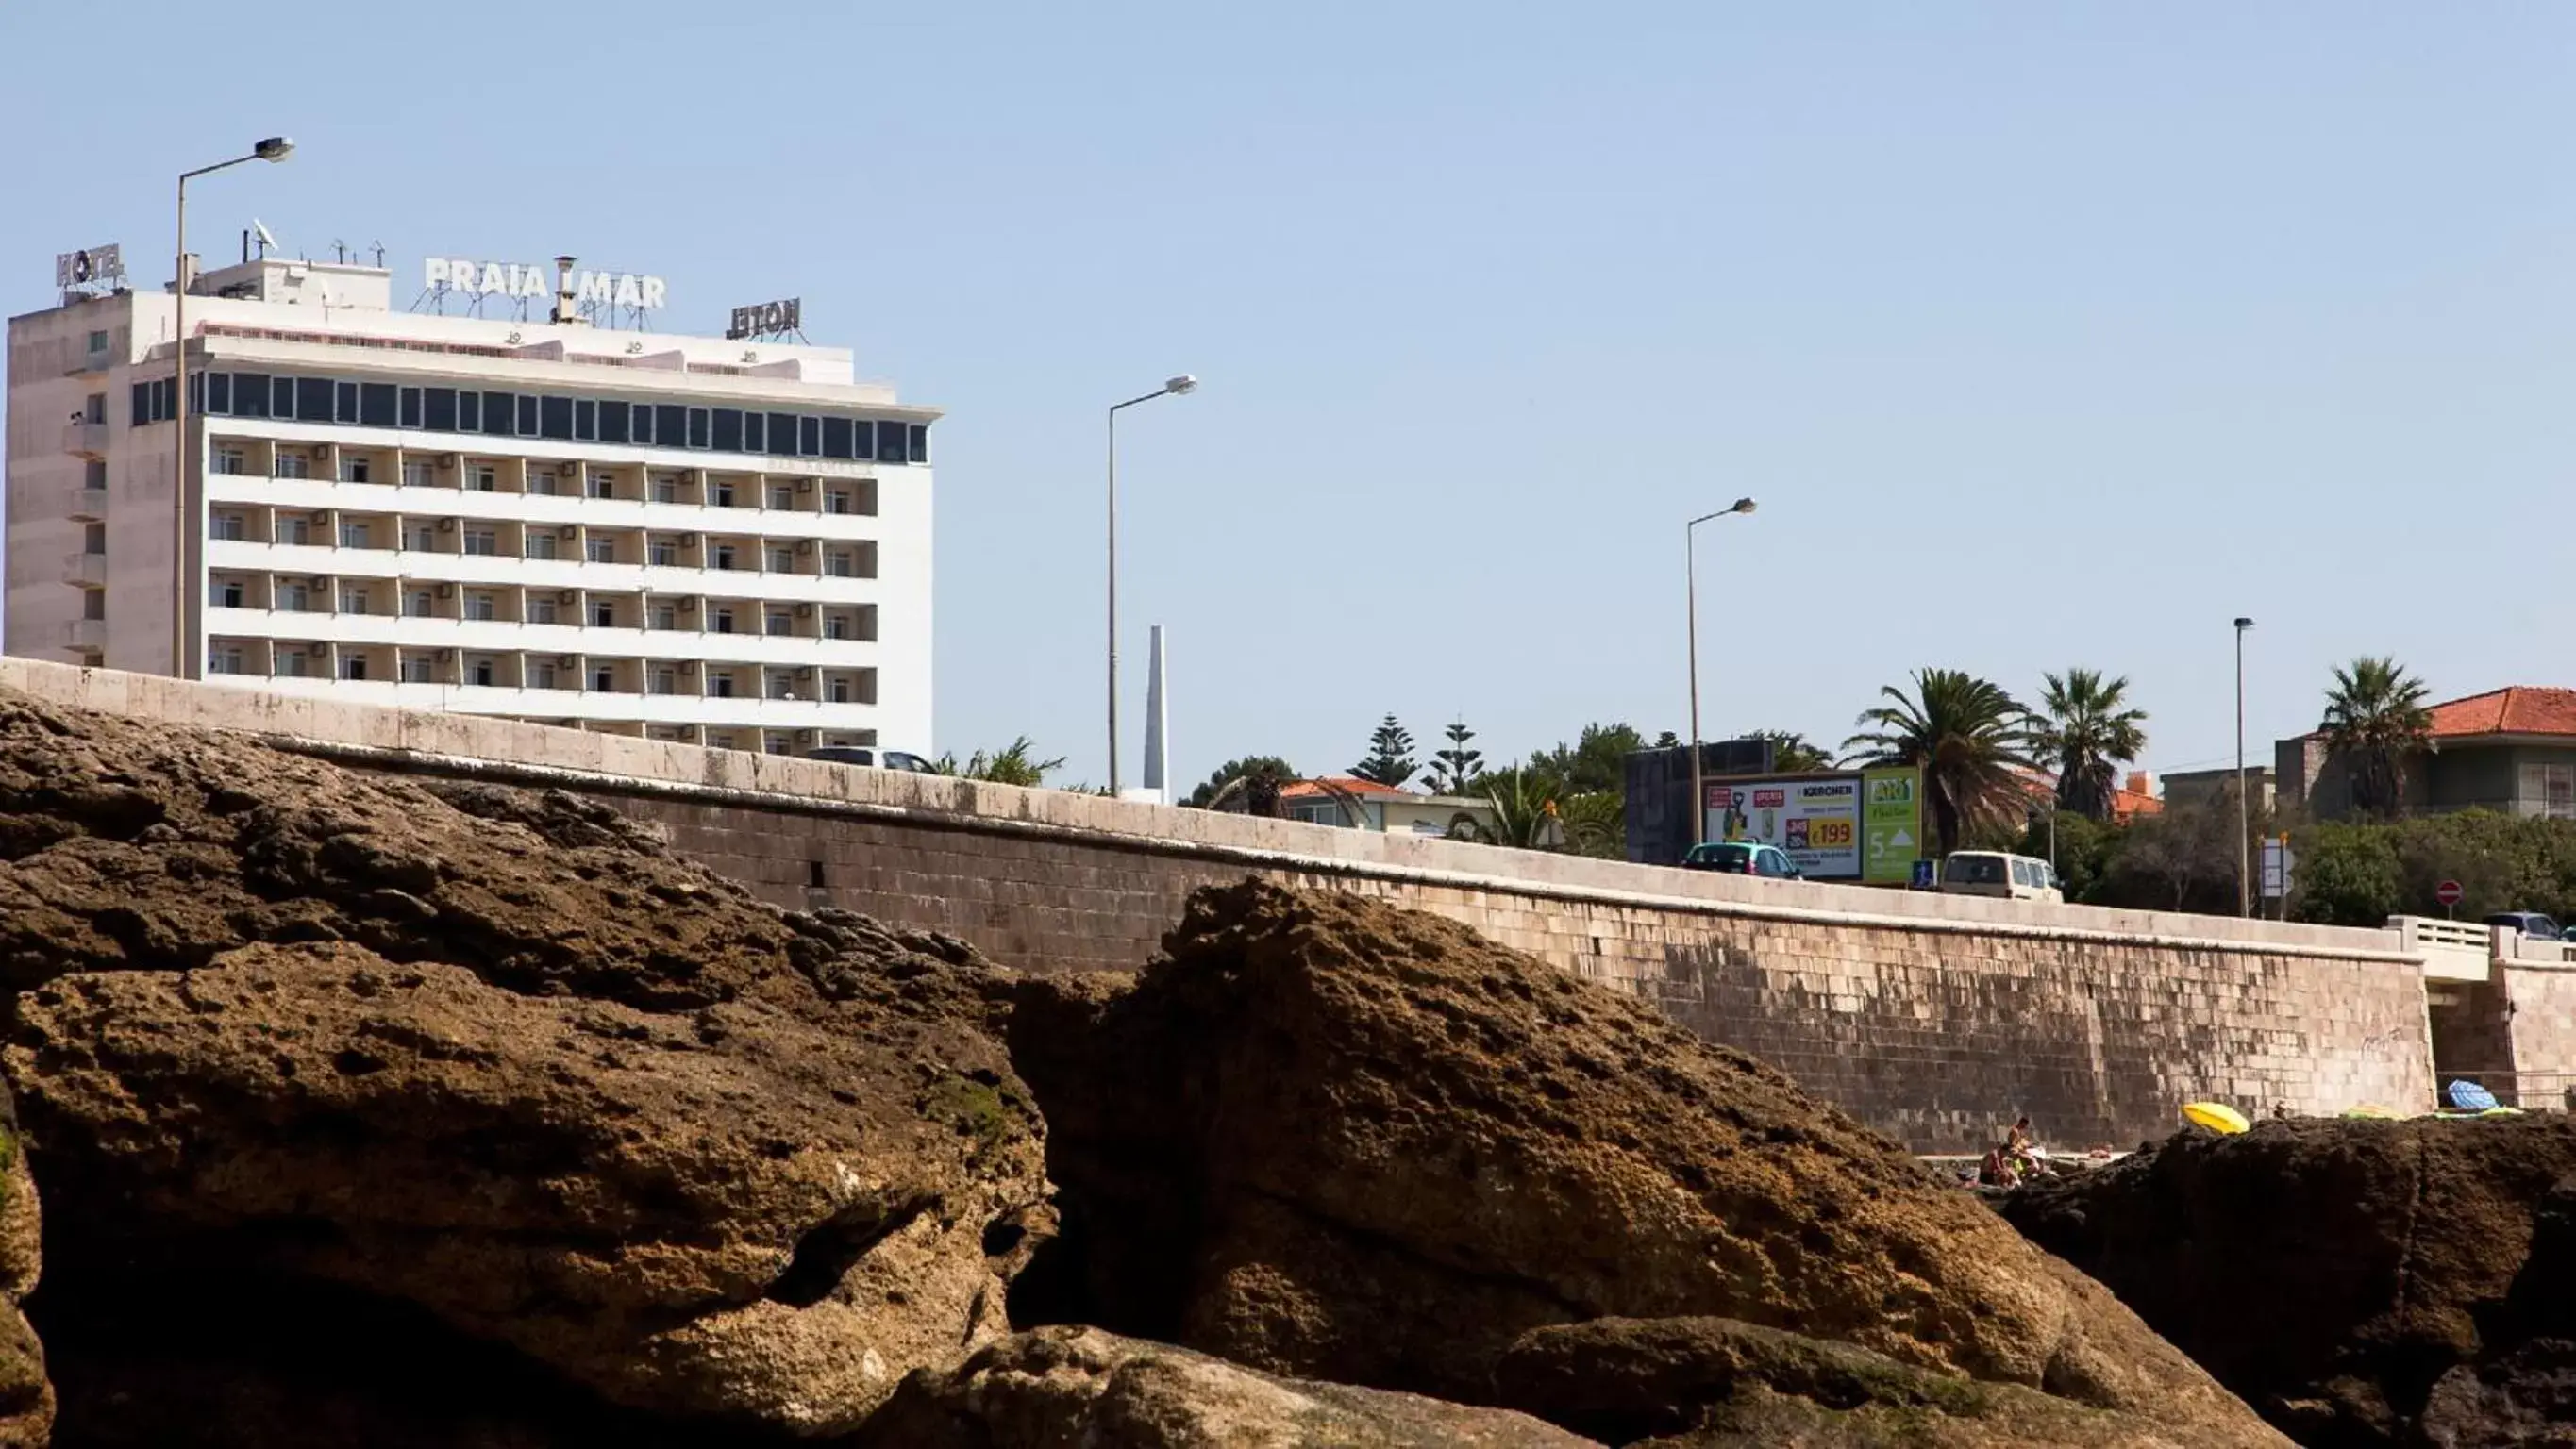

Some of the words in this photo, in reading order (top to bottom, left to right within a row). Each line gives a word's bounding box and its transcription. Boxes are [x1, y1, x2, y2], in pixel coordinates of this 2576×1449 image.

[57, 242, 124, 287] HOTEL
[425, 258, 548, 297] PRAIA
[577, 271, 664, 308] MAR
